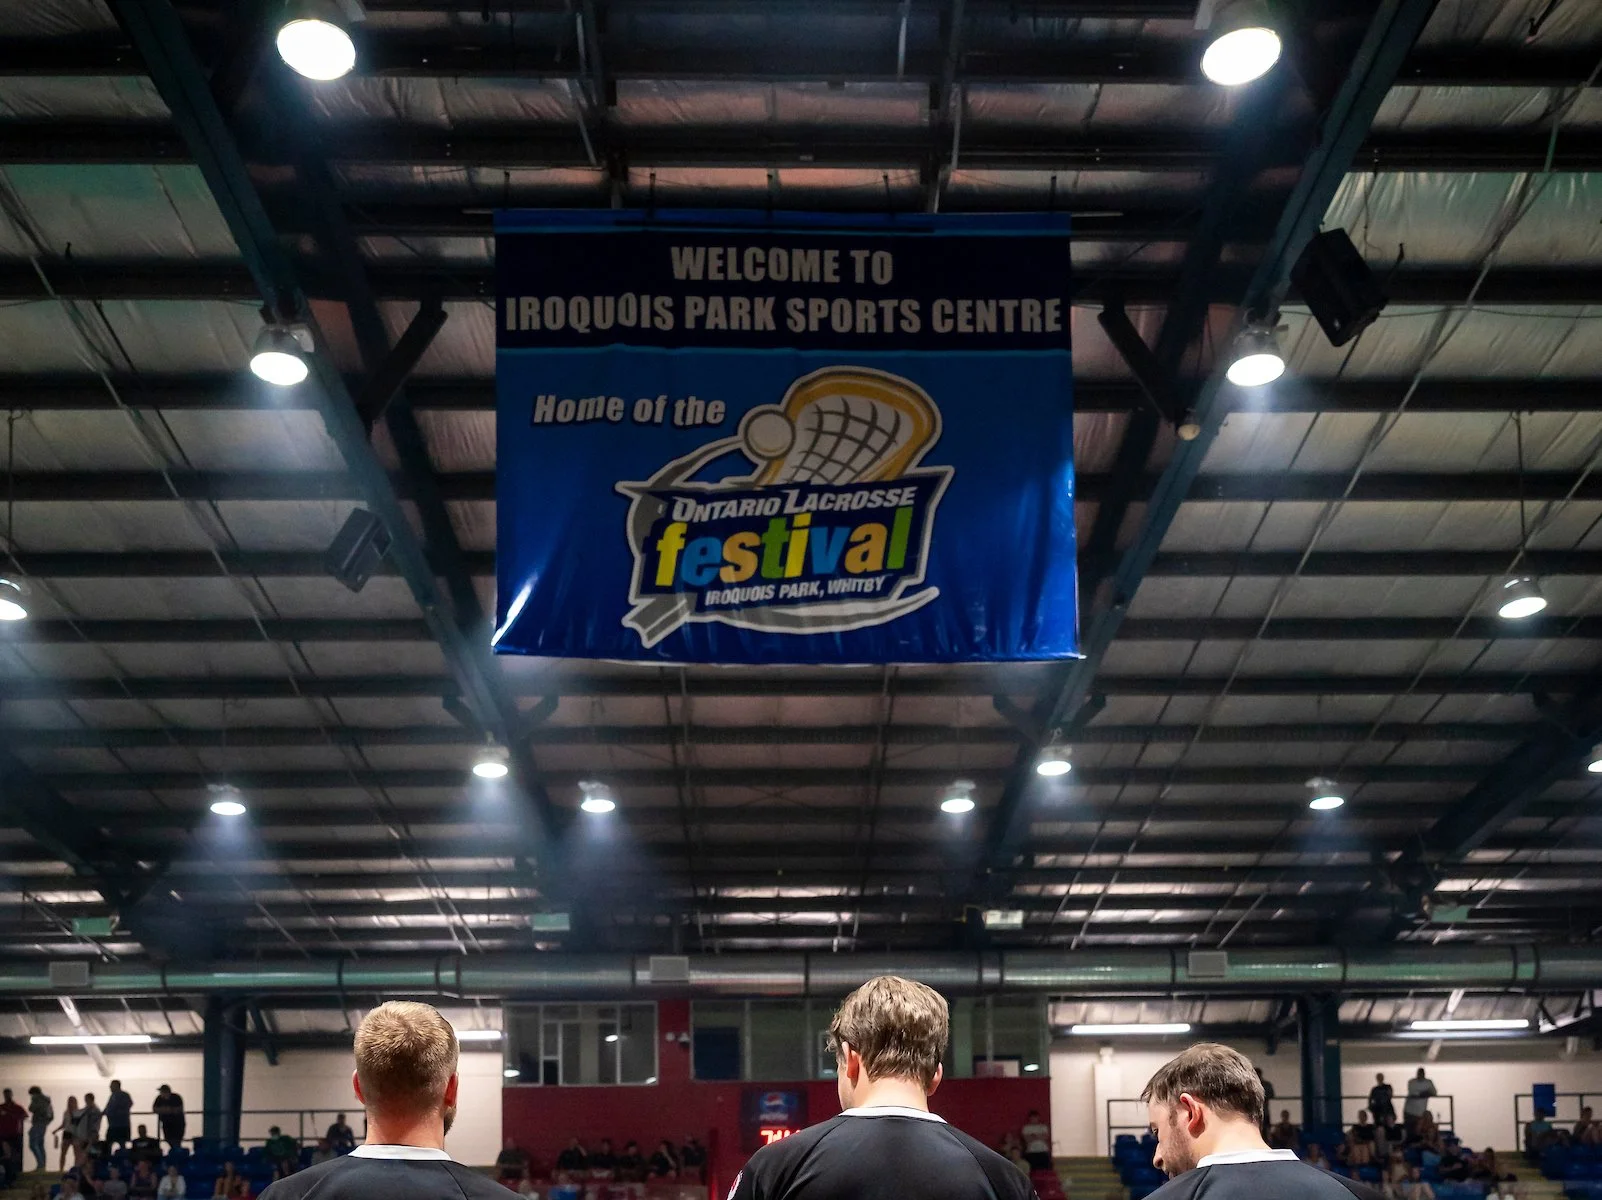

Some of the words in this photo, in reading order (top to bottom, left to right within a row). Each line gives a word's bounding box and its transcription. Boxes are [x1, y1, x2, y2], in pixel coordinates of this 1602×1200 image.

[671, 246, 840, 284] WELCOME
[850, 248, 894, 286] TO
[505, 292, 675, 334] IROQUOIS
[686, 296, 777, 332] PARK
[786, 298, 921, 333] SPORTS
[932, 298, 1062, 333] CENTRE
[533, 394, 625, 423] Home
[633, 394, 668, 423] of
[673, 396, 726, 426] the
[672, 496, 783, 523] ONTARIO
[782, 487, 918, 514] LACROSSE
[655, 506, 914, 587] festival
[705, 585, 775, 606] IROQUOIS
[779, 582, 825, 599] PARK,
[828, 575, 890, 594] WHITBY
